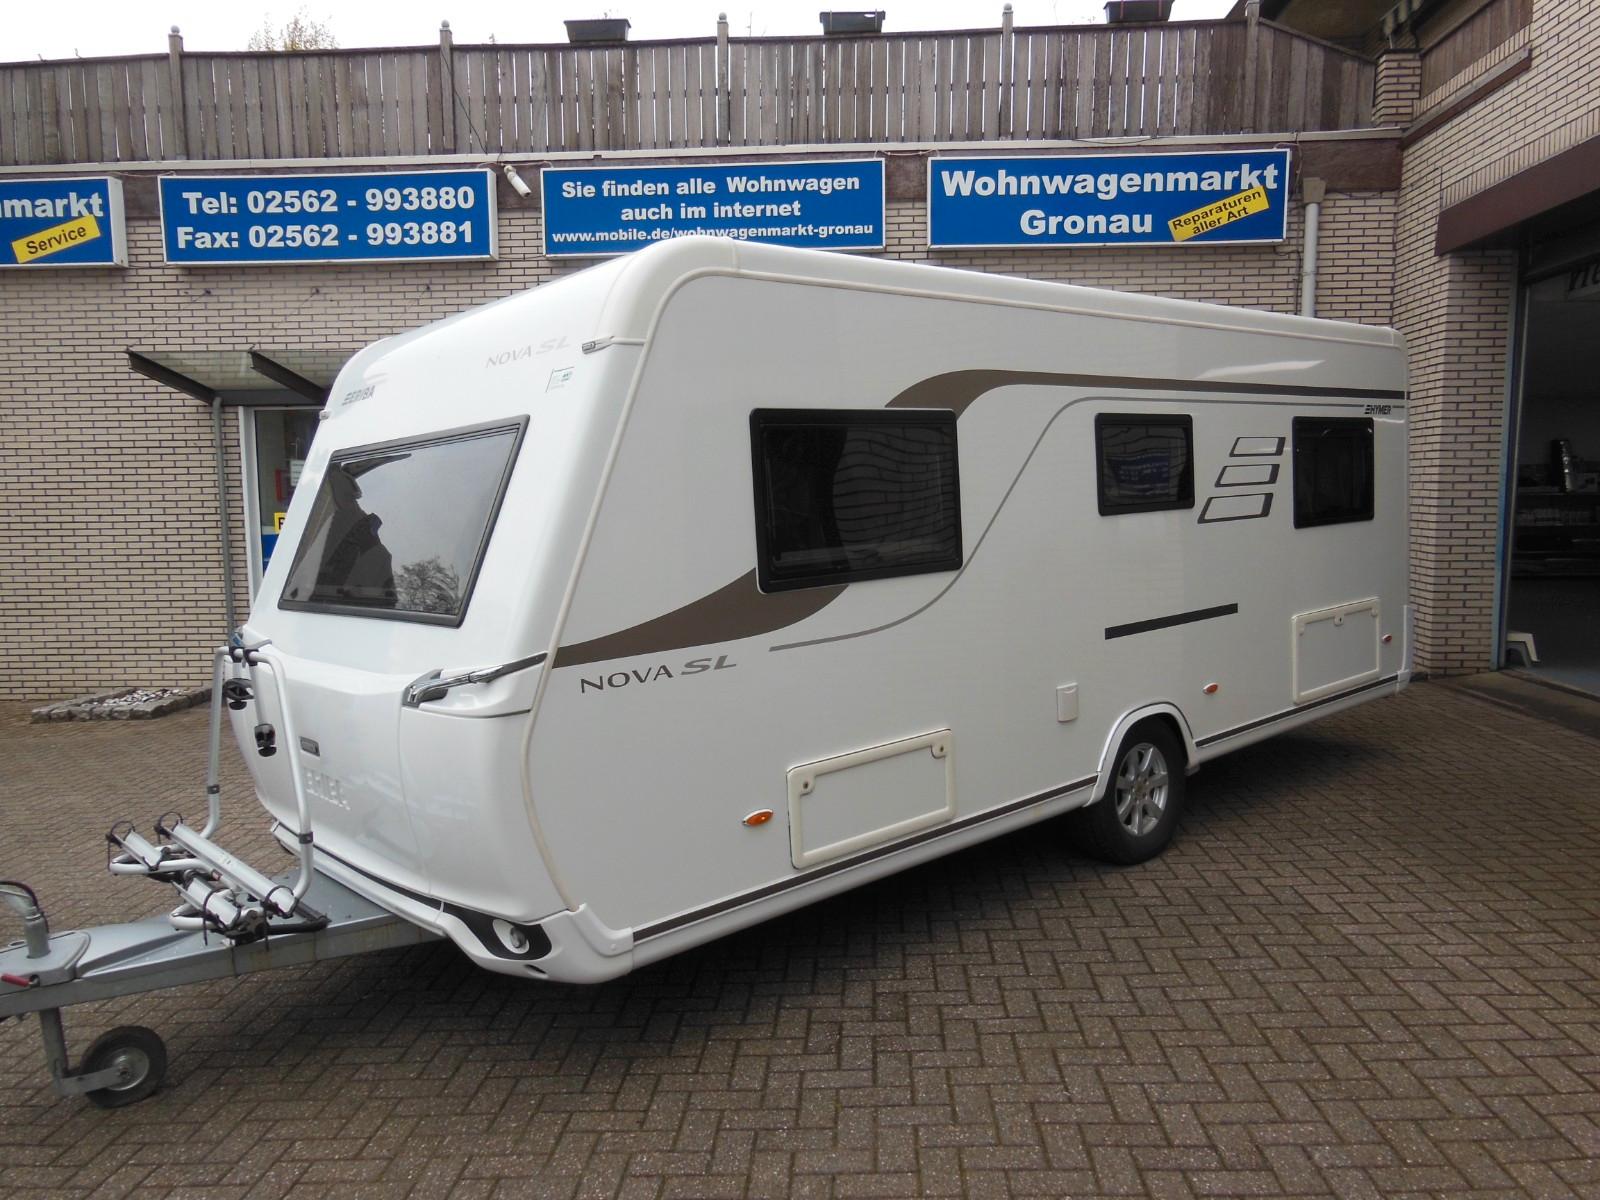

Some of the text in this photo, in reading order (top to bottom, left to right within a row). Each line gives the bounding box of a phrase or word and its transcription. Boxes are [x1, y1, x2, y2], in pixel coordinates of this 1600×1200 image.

[562, 175, 860, 198] Sie finden alle Wohnwagen
[941, 163, 1278, 199] Wohnwagenmarkt
[0, 192, 104, 218] markt
[182, 191, 237, 214] Tel:
[247, 189, 338, 214] 02562
[366, 186, 475, 212] 993880
[620, 200, 801, 221] auch im internet
[1172, 191, 1261, 231] Reparaturen
[552, 223, 873, 242] www.mobile.de/wohnwagenmarkt-gronau
[1020, 209, 1153, 236] Gronau
[1192, 206, 1249, 235] aller Art
[26, 226, 86, 255] Service
[176, 226, 239, 249] Fax:
[248, 224, 338, 248] 02562
[367, 221, 472, 245] 993881
[485, 336, 571, 368] NOVA SL
[580, 654, 737, 694] NOVA SL
